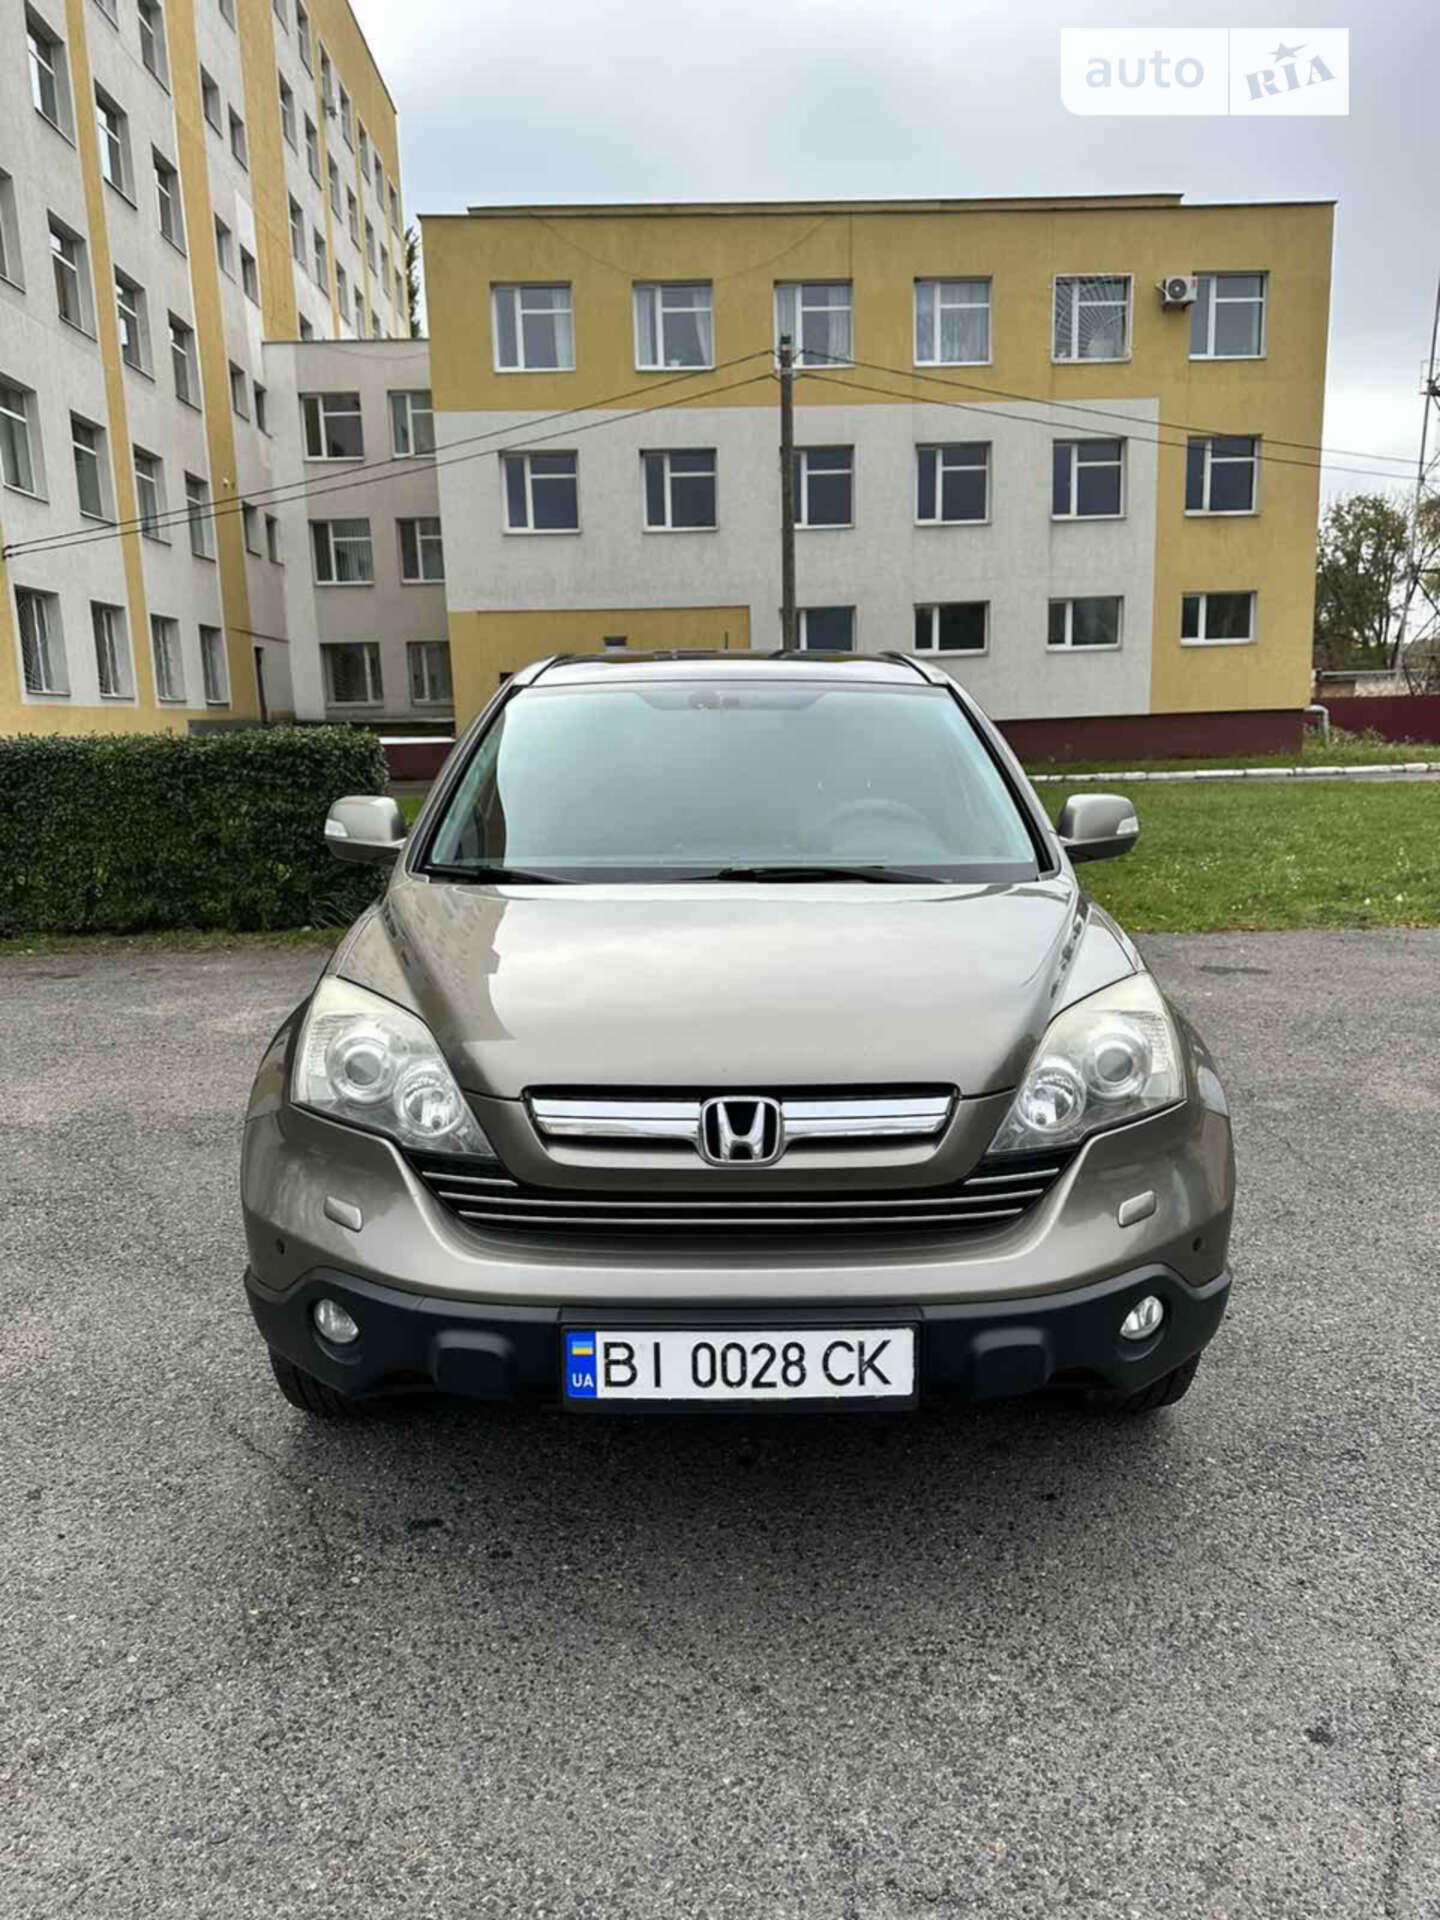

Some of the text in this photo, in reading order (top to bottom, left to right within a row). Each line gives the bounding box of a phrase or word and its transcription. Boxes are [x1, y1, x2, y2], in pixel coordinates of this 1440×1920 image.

[603, 1339, 892, 1388] BI 0028 CK
[572, 1373, 595, 1388] UA
